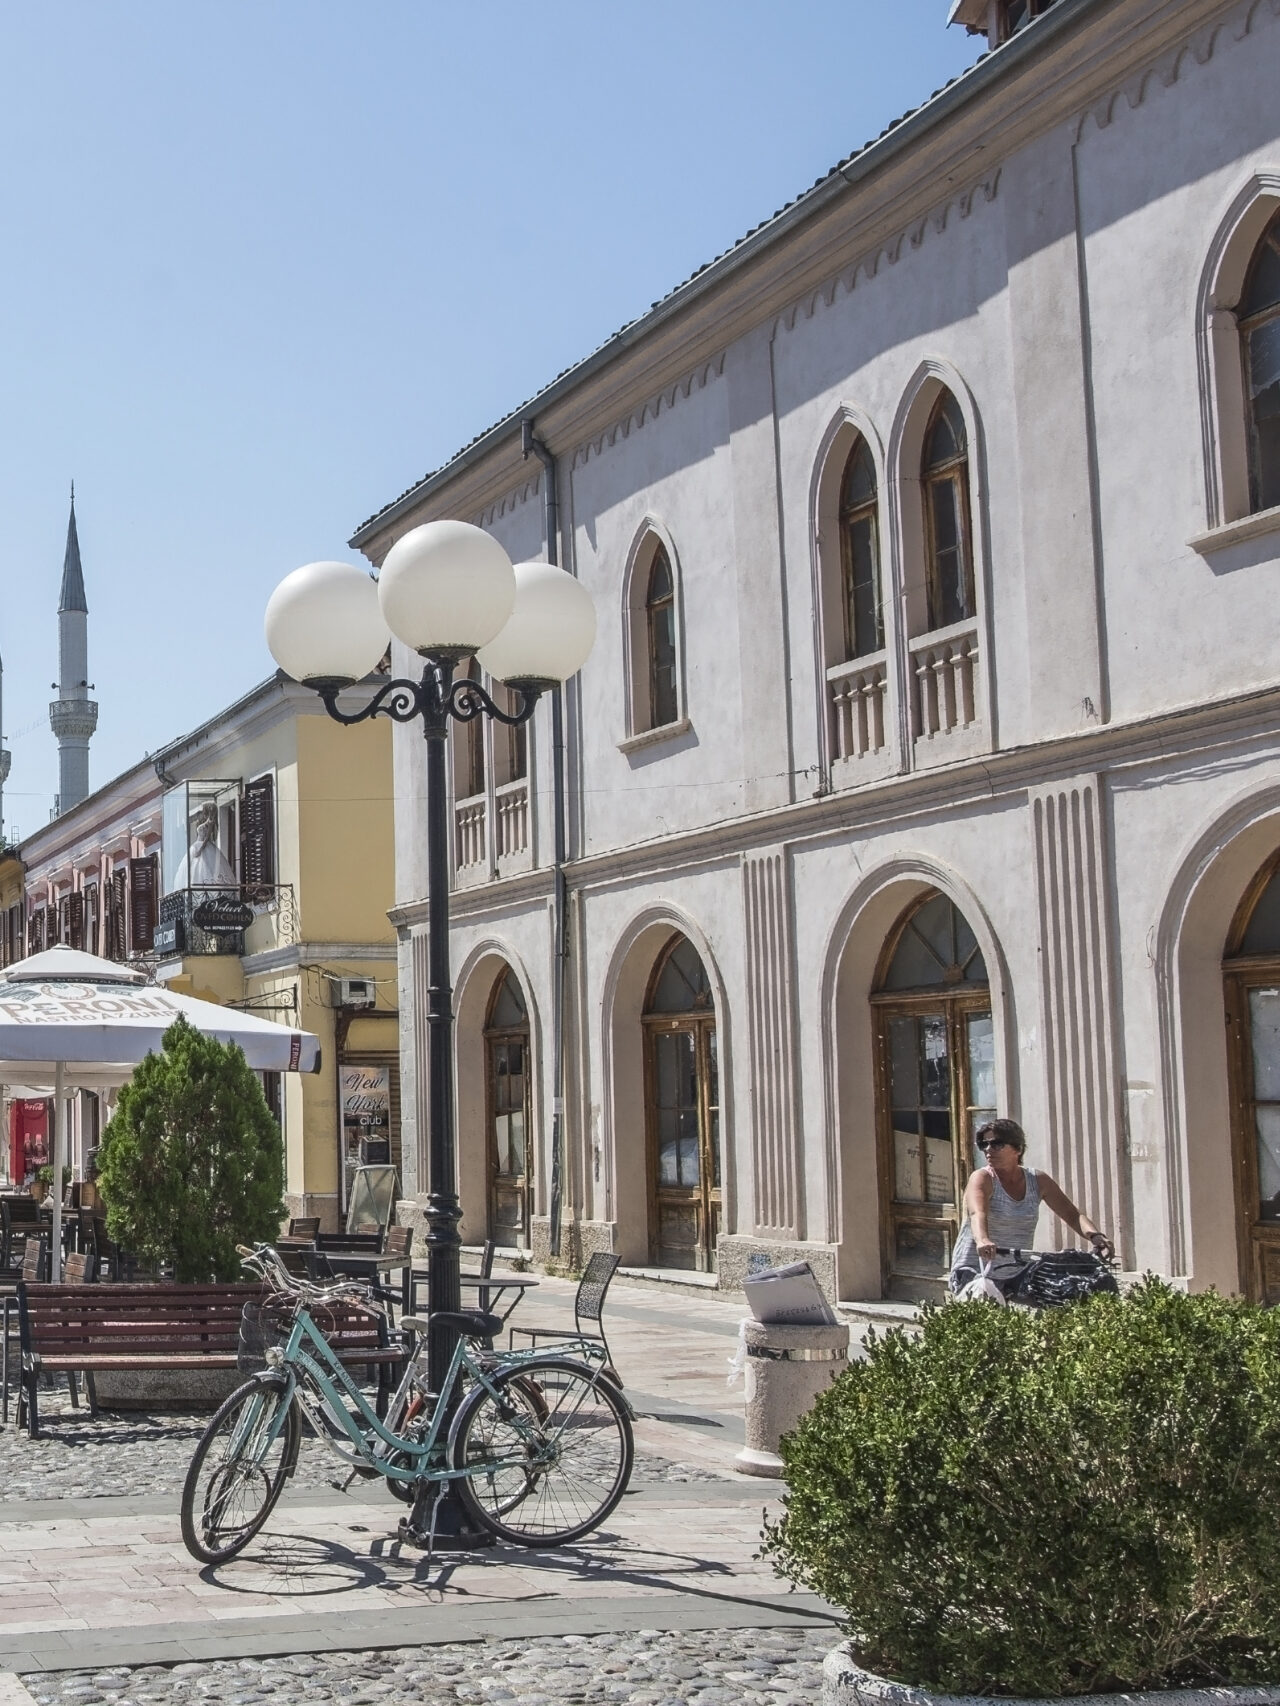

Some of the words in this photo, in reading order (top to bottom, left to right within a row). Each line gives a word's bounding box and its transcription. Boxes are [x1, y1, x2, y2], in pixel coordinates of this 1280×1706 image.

[15, 1014, 99, 1024] NASTRO
[290, 1042, 300, 1070] PERONI
[346, 1072, 384, 1092] New
[346, 1094, 385, 1114] York
[360, 1115, 382, 1126] club
